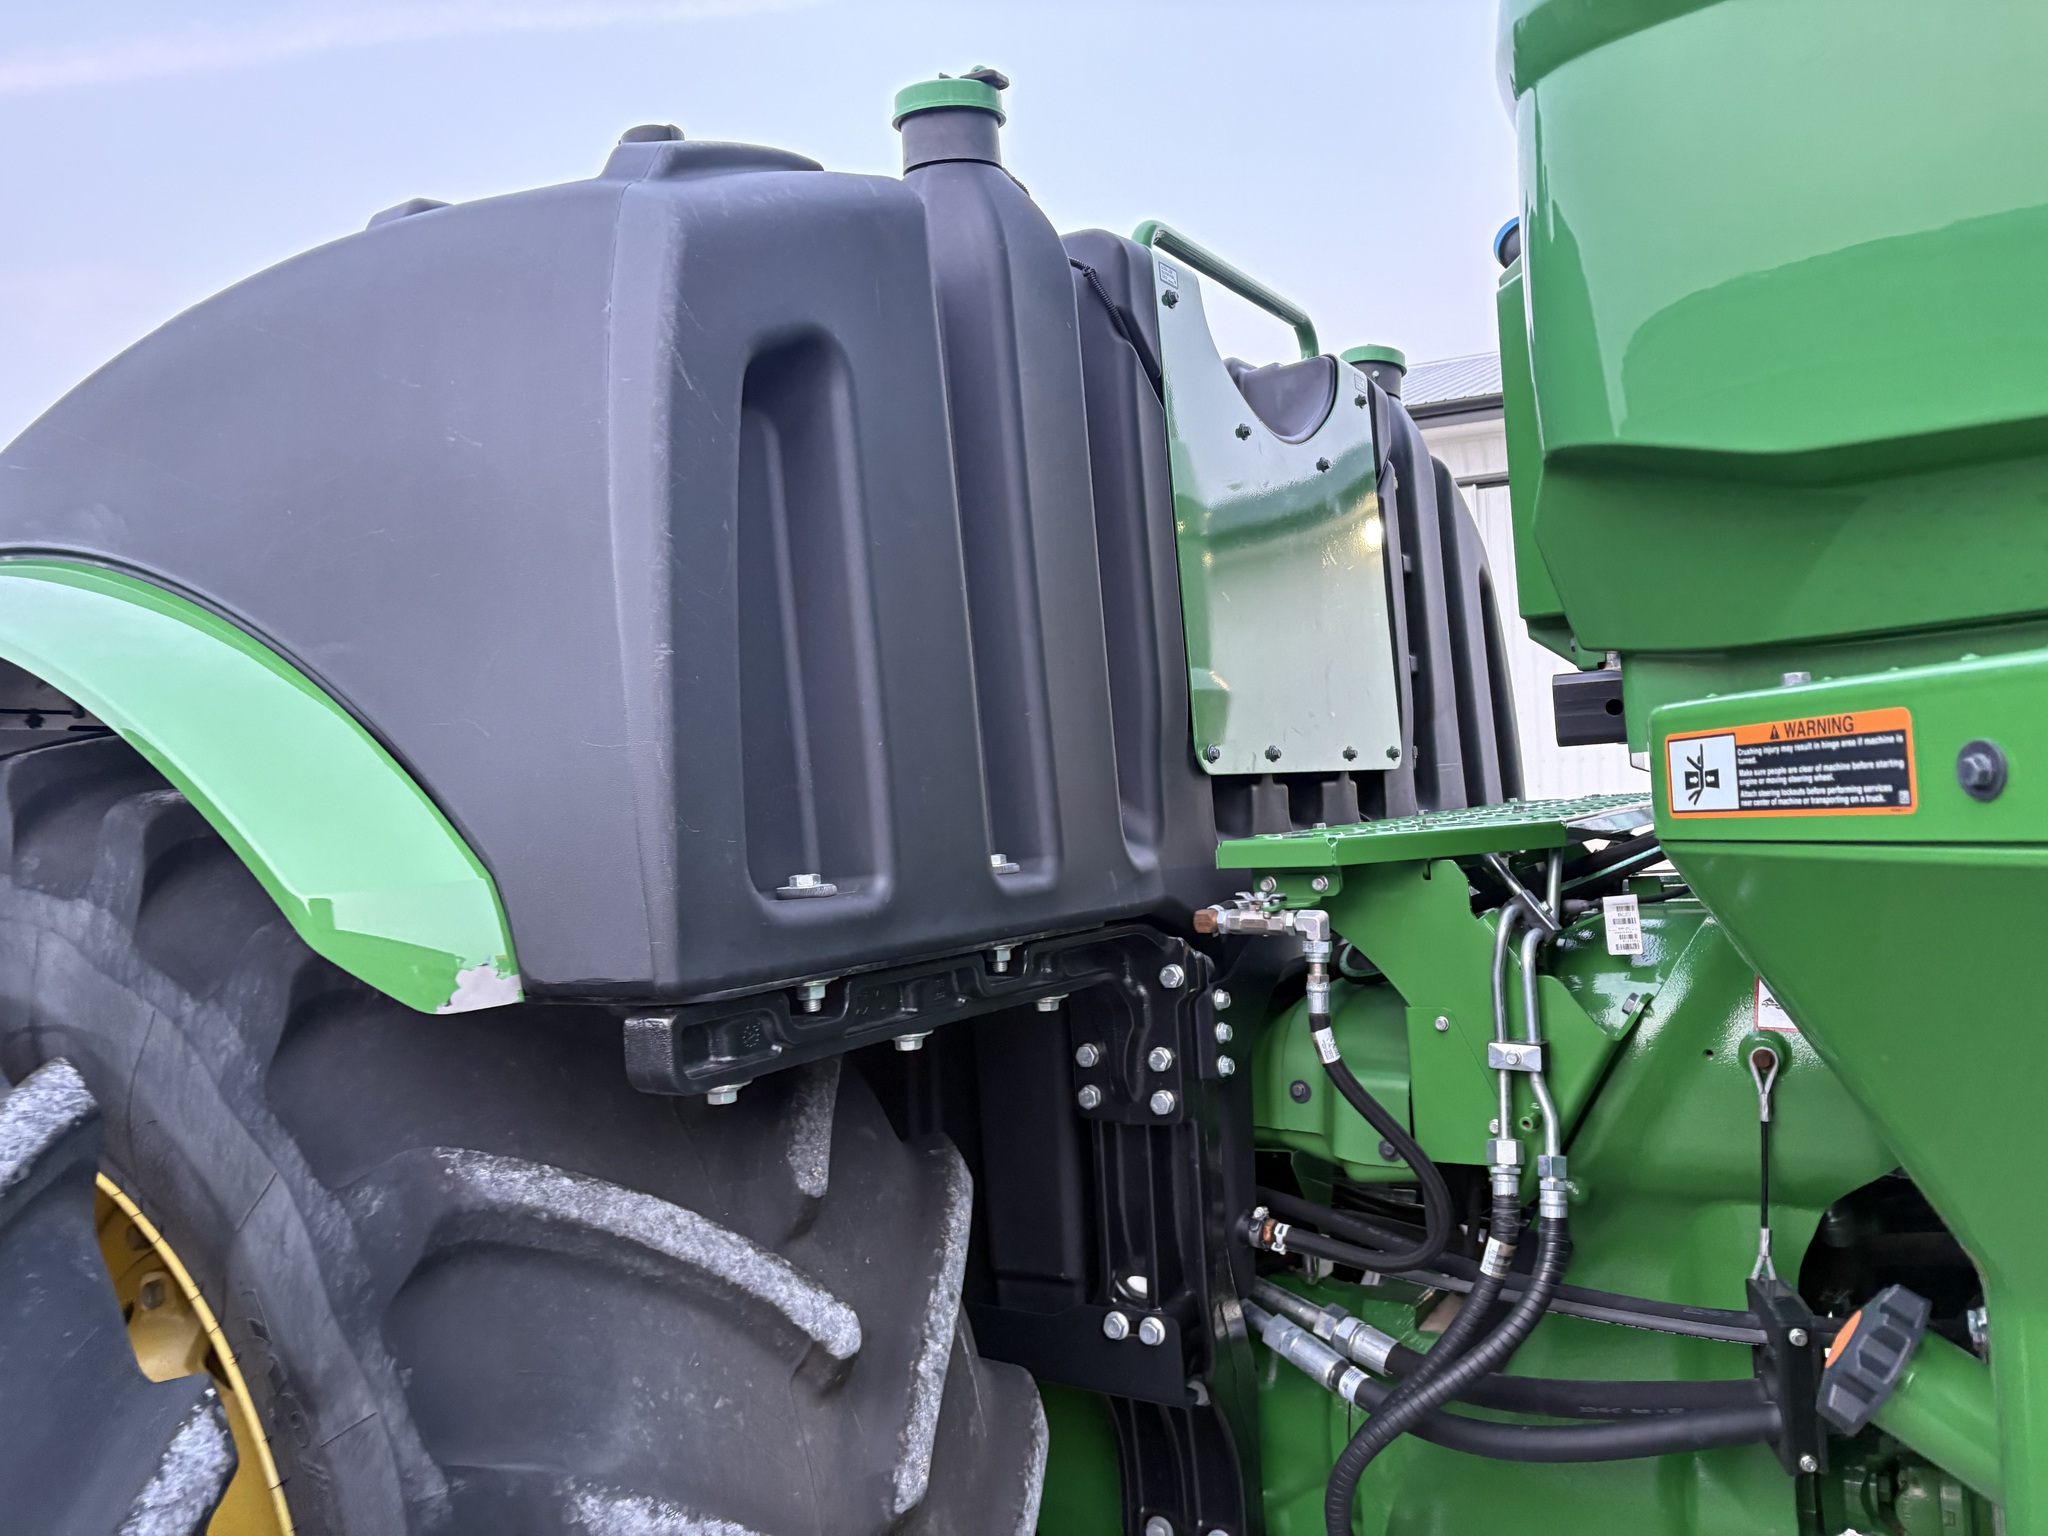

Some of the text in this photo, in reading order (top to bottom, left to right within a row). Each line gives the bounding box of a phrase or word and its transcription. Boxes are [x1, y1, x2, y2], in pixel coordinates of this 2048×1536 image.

[1784, 716, 1853, 738] WARNING
[1738, 748, 1762, 756] Crushing
[1763, 746, 1779, 755] injury
[1794, 742, 1812, 751] result
[1864, 735, 1894, 745] machine
[1896, 734, 1904, 742] is
[1768, 767, 1786, 777] people
[1823, 763, 1850, 771] machine
[1876, 760, 1904, 769] starting
[1827, 785, 1862, 795] performing
[1811, 795, 1849, 806] transporting
